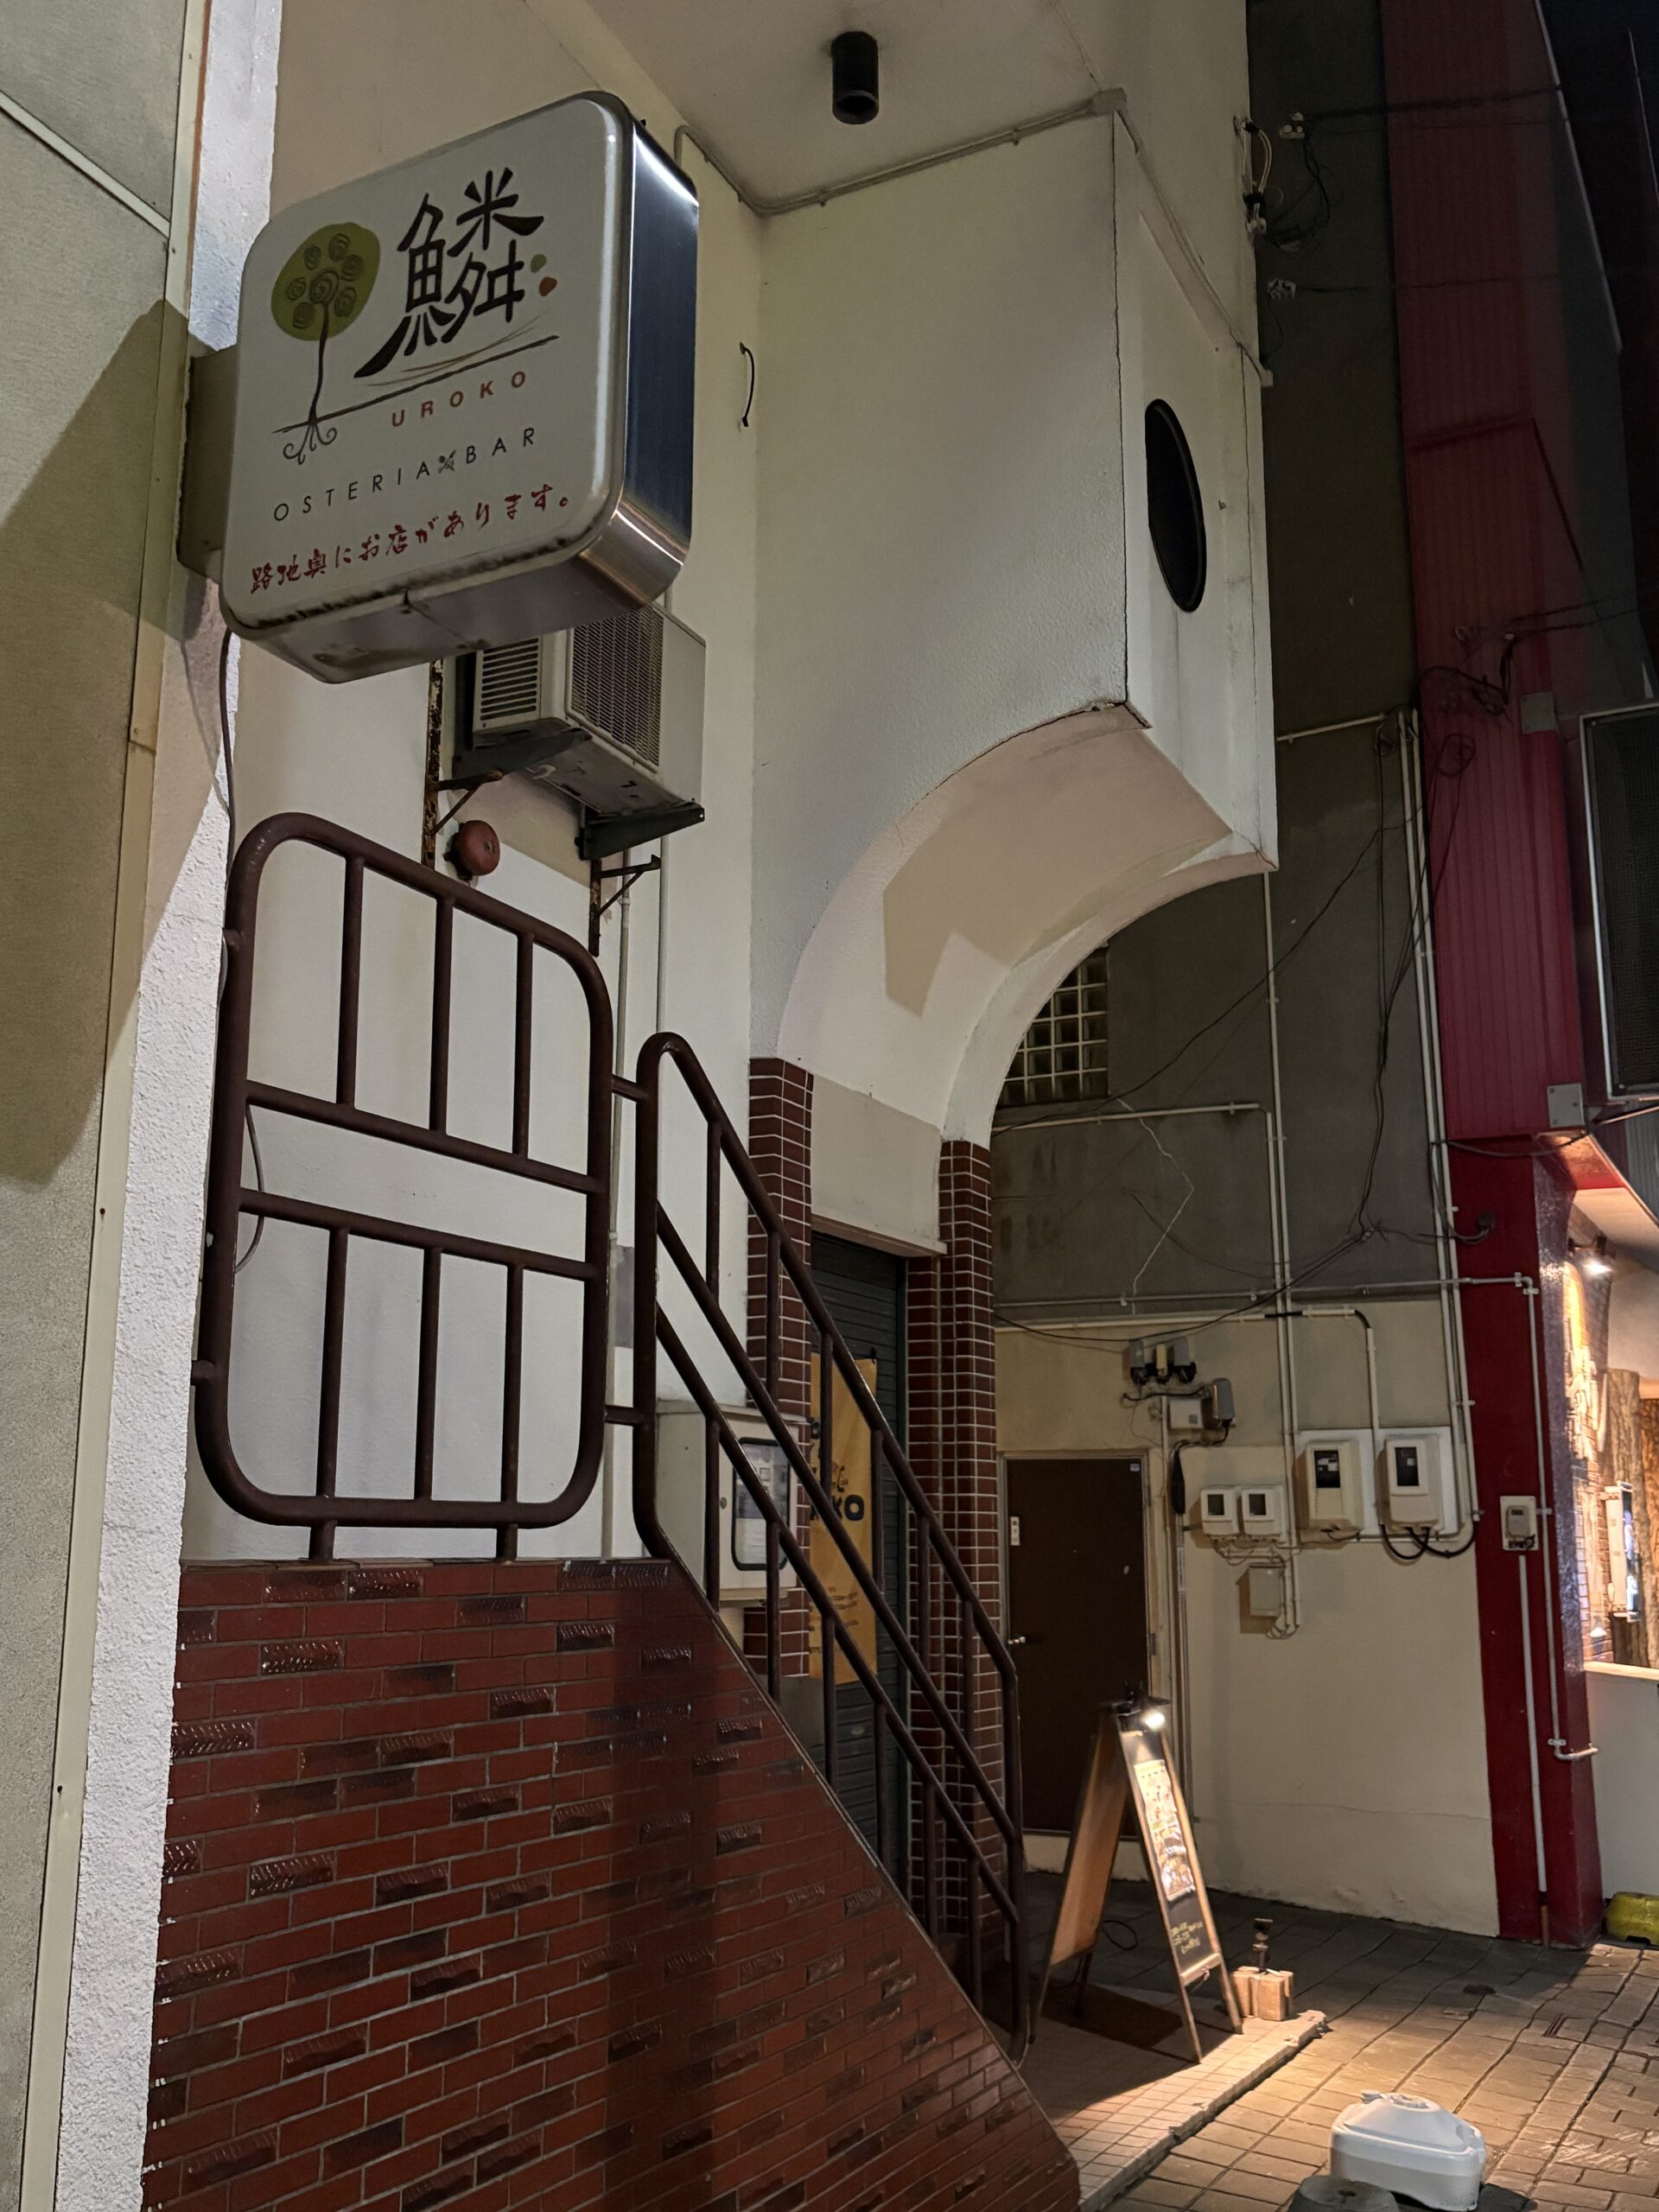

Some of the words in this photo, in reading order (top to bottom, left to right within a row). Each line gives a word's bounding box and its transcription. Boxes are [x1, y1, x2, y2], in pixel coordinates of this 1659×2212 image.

[354, 167, 544, 378] 鱗
[391, 371, 526, 427] UROKO
[273, 461, 430, 521] OSTERIA
[465, 427, 535, 464] BAR
[250, 483, 569, 594] 路地奥にお店があります。
